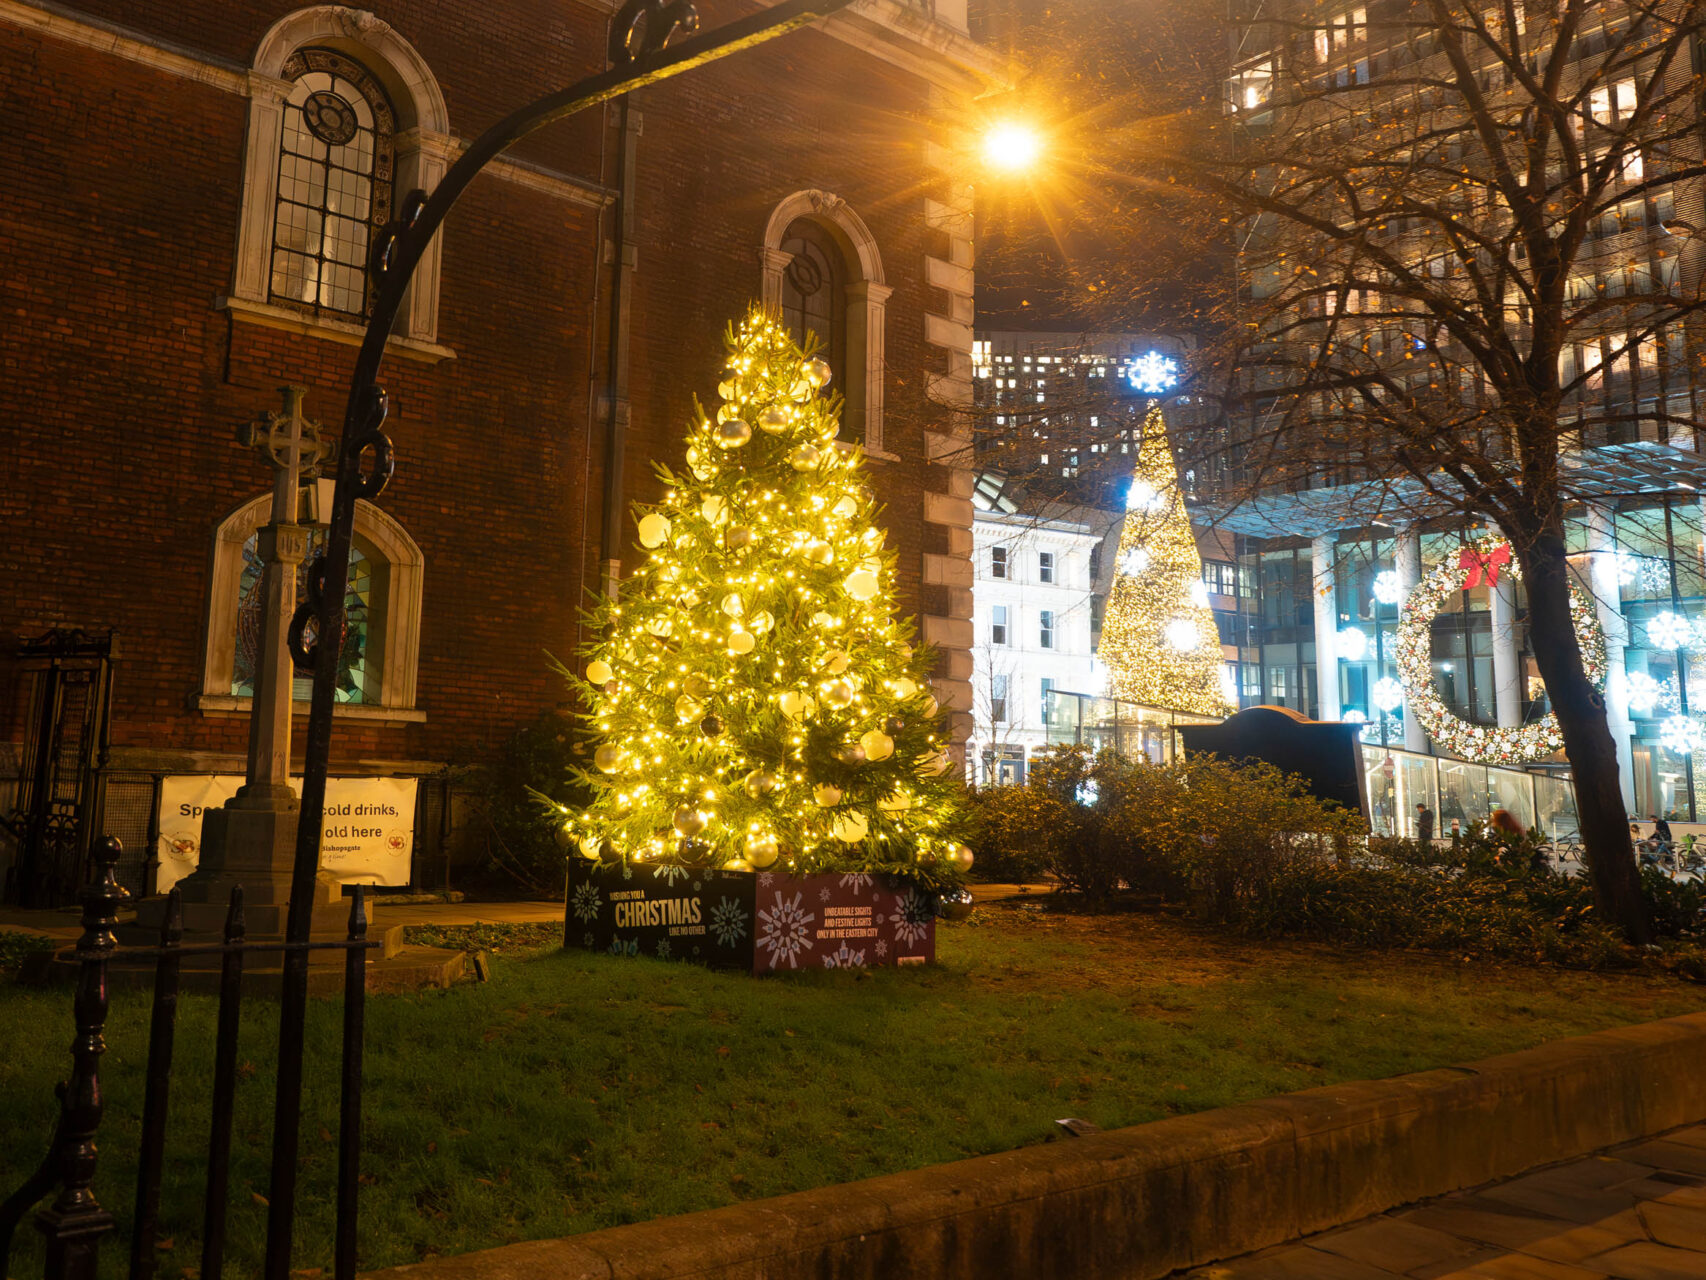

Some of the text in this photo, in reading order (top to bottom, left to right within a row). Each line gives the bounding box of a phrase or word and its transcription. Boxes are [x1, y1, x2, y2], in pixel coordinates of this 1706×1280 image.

[354, 803, 399, 818] drinks,
[325, 825, 382, 839] old here
[615, 896, 702, 928] CHRISTMAS
[824, 906, 872, 917] UNBEATABLE SIGHTS
[824, 917, 872, 928] AND FESTIVE LIGHTS
[669, 925, 706, 937] LIKE NO OTHER
[816, 927, 878, 939] ONLY IN THE EASTERN CITY
